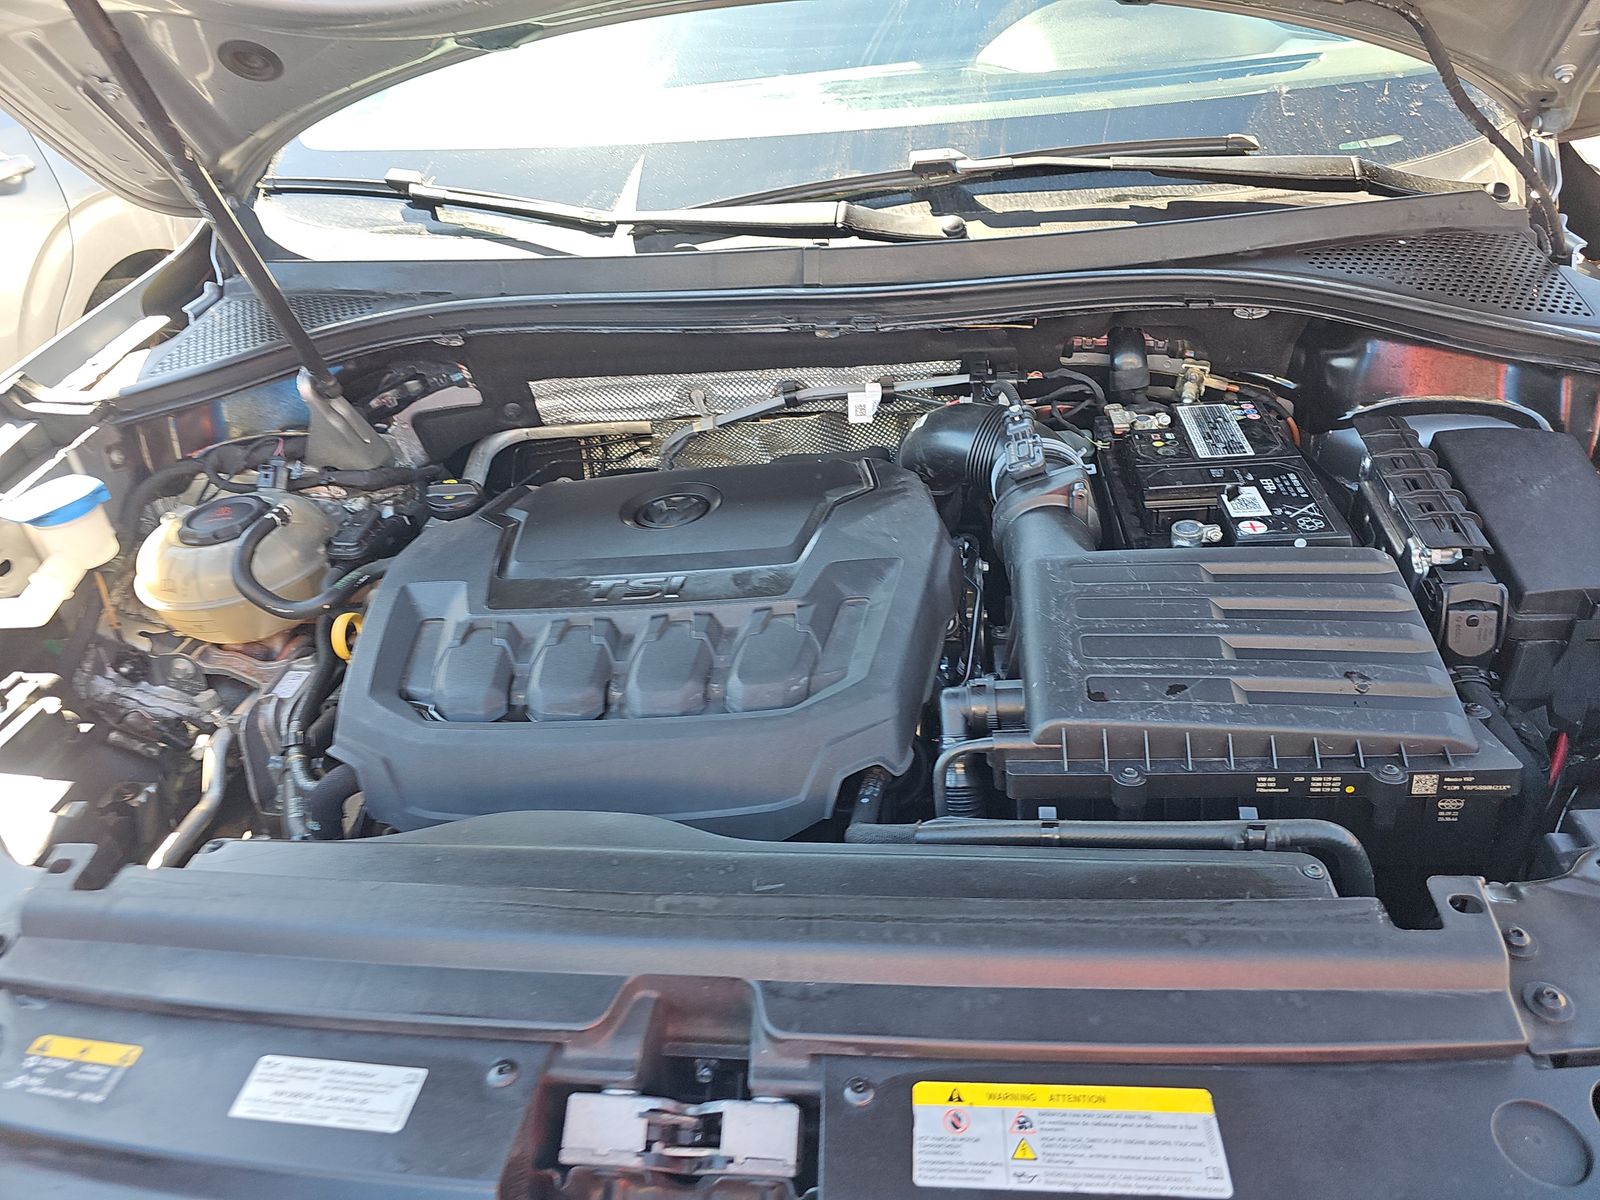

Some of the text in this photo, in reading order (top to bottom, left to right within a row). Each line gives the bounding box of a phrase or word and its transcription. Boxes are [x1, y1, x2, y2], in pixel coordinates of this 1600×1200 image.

[1259, 478, 1277, 495] EFB+
[590, 575, 688, 602] TSI
[986, 1091, 1107, 1104] WARNING ATTENTION
